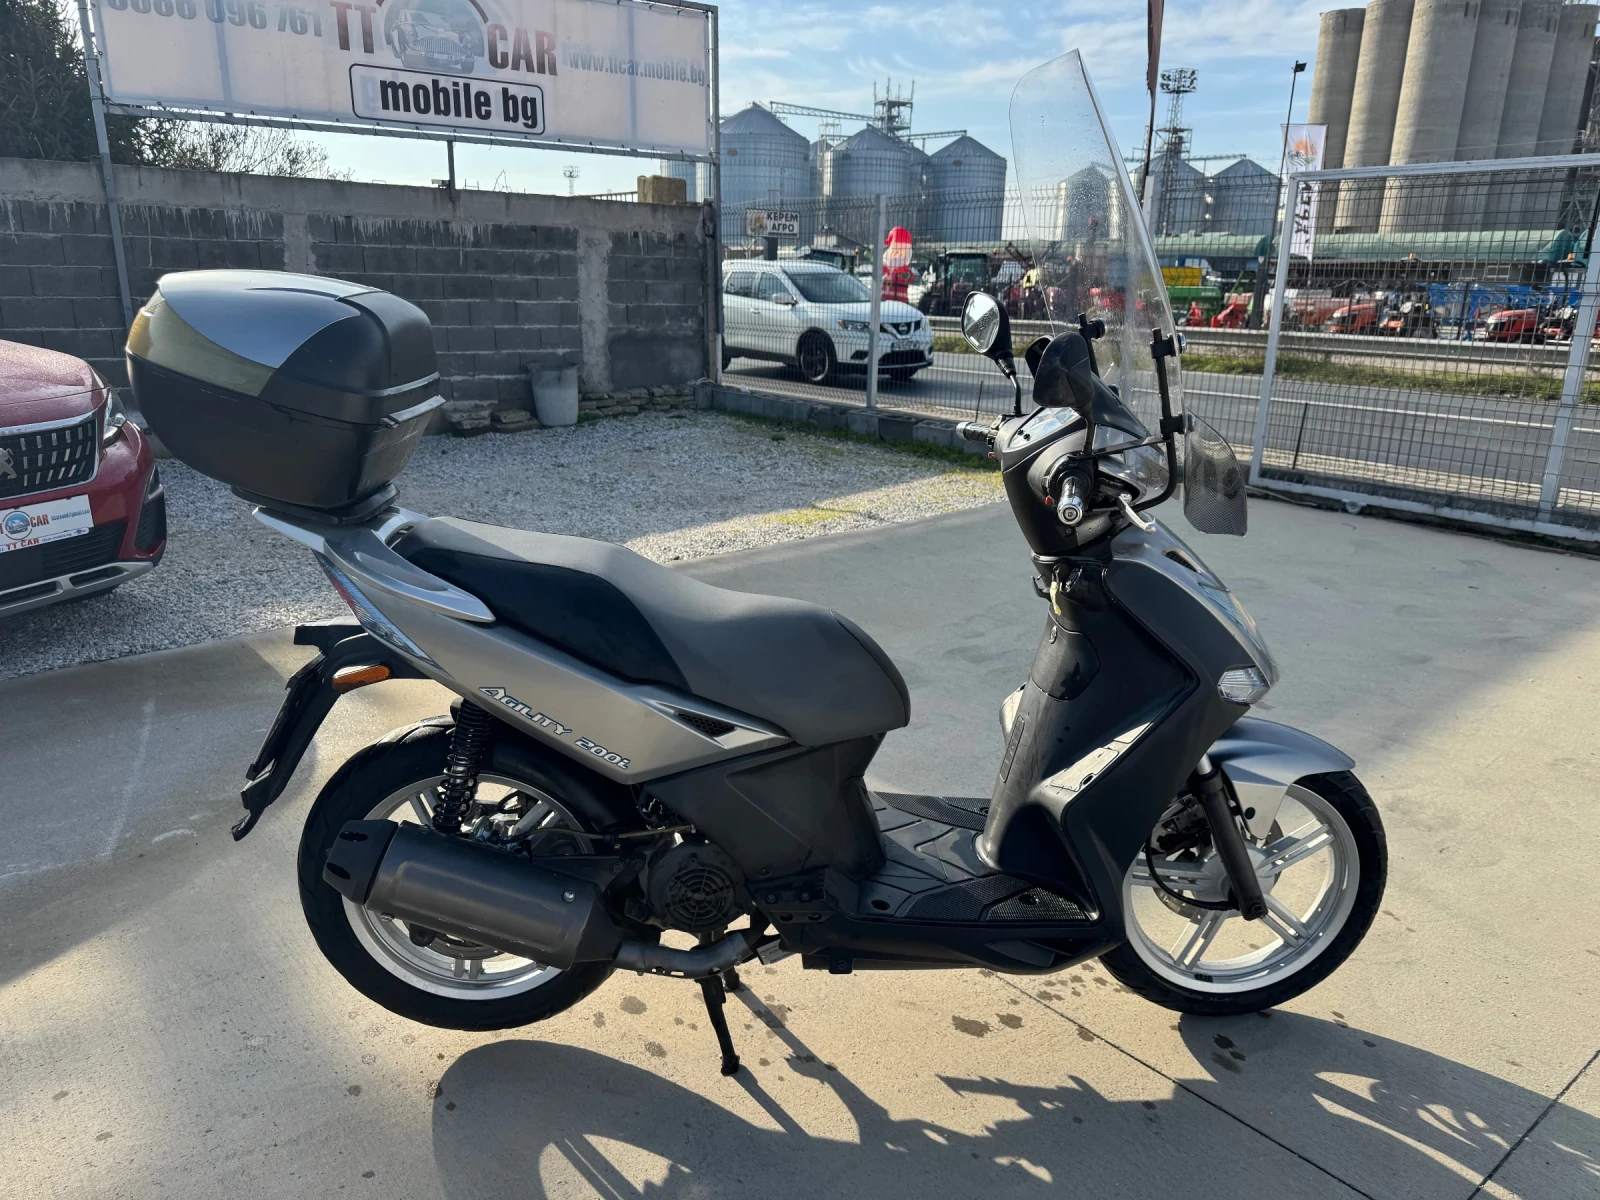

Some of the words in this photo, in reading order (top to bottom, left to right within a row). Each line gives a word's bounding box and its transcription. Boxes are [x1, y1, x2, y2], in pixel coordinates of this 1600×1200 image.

[272, 2, 322, 37] 761
[330, 1, 376, 54] TT
[487, 24, 558, 76] CAR
[568, 51, 705, 87] www.ttcar.mobile.bg
[379, 79, 492, 120] mobile
[502, 87, 538, 128] bg
[767, 212, 798, 222] КЕРЕМ
[771, 223, 794, 232] АГРО
[30, 514, 50, 528] CAR
[6, 542, 17, 551] TT
[21, 537, 40, 548] CAR
[479, 687, 573, 736] AGILITY
[574, 736, 631, 770] 200i
